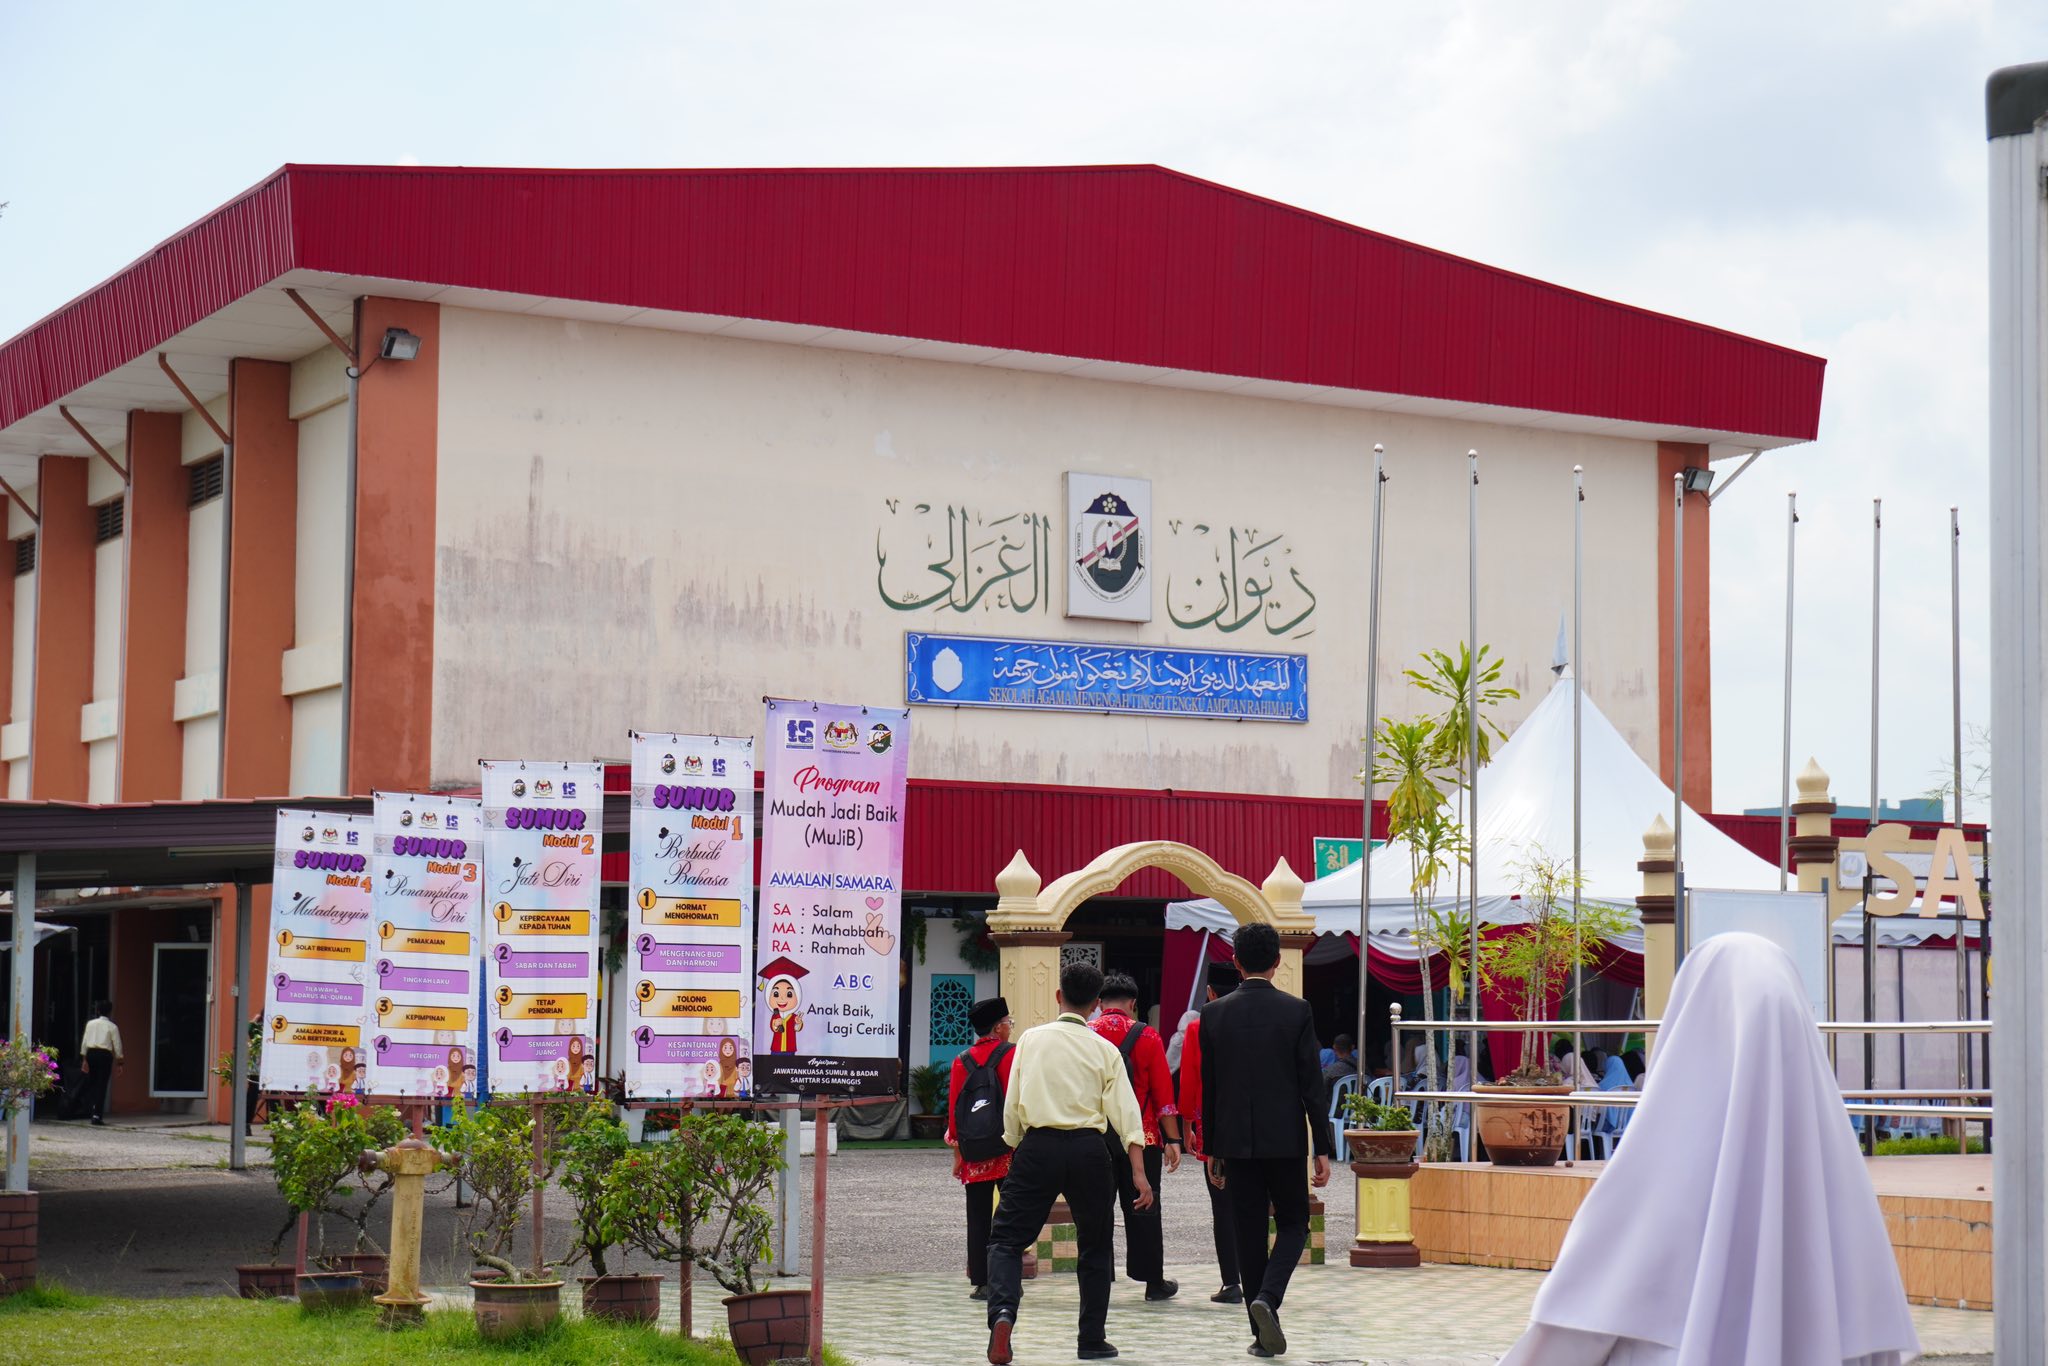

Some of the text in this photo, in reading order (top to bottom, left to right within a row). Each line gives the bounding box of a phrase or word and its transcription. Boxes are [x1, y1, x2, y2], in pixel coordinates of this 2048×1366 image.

[989, 687, 1294, 716] SEKOLAH AGAMA MENENGAH TINGGI TENGKU AMPUAN RAHIMAH
[793, 765, 880, 796] Program
[653, 784, 736, 812] SUMUR
[770, 799, 898, 822] Mudah Jadi Baik
[505, 807, 586, 831] SUMUR
[691, 815, 744, 841] Modul 1
[543, 834, 594, 855] Modul 2
[804, 824, 864, 851] (MuJiB)
[392, 835, 467, 859] SUMUR
[655, 833, 726, 860] Berbudi
[294, 850, 367, 873] SUMUR
[426, 861, 477, 882] Modul 3
[500, 861, 582, 894] Jati Diri
[664, 859, 730, 887] Bahasa
[326, 874, 372, 893] Modul 4
[385, 874, 469, 904] Penampilan
[769, 872, 894, 891] AMALAN SAMARA
[643, 891, 650, 907] 1
[675, 903, 707, 911] HORMAT
[281, 896, 370, 925] Mutadayyin
[430, 900, 467, 924] Diri
[499, 904, 506, 919] 1
[665, 912, 719, 921] MENGHORMATI
[773, 903, 791, 916] SA
[812, 904, 853, 919] Salam
[772, 922, 796, 934] MA
[811, 924, 884, 938] Mahabbah
[407, 937, 446, 945] PEMAKAIAN
[641, 937, 651, 952] 2
[772, 940, 791, 953] RA
[811, 943, 865, 956] Rahmah
[499, 946, 508, 960] 2
[659, 950, 706, 958] MENGENANG
[381, 961, 388, 974] 2
[278, 975, 285, 987] 2
[403, 976, 450, 985] TINGKAH LAKU
[833, 974, 872, 989] A B C
[499, 988, 508, 1003] 3
[640, 983, 650, 999] 3
[379, 1000, 388, 1013] 3
[672, 1004, 713, 1012] MENOLONG
[806, 1004, 874, 1019] Anak Baik,
[275, 1017, 283, 1029] 3
[406, 1013, 445, 1022] KEPIMPINAN
[499, 1030, 509, 1045] 4
[638, 1028, 649, 1045] 4
[827, 1021, 896, 1038] Lagi Cerdik
[377, 1037, 388, 1051] 4
[668, 1041, 718, 1049] KESANTUNAN
[691, 1050, 719, 1058] BICARA
